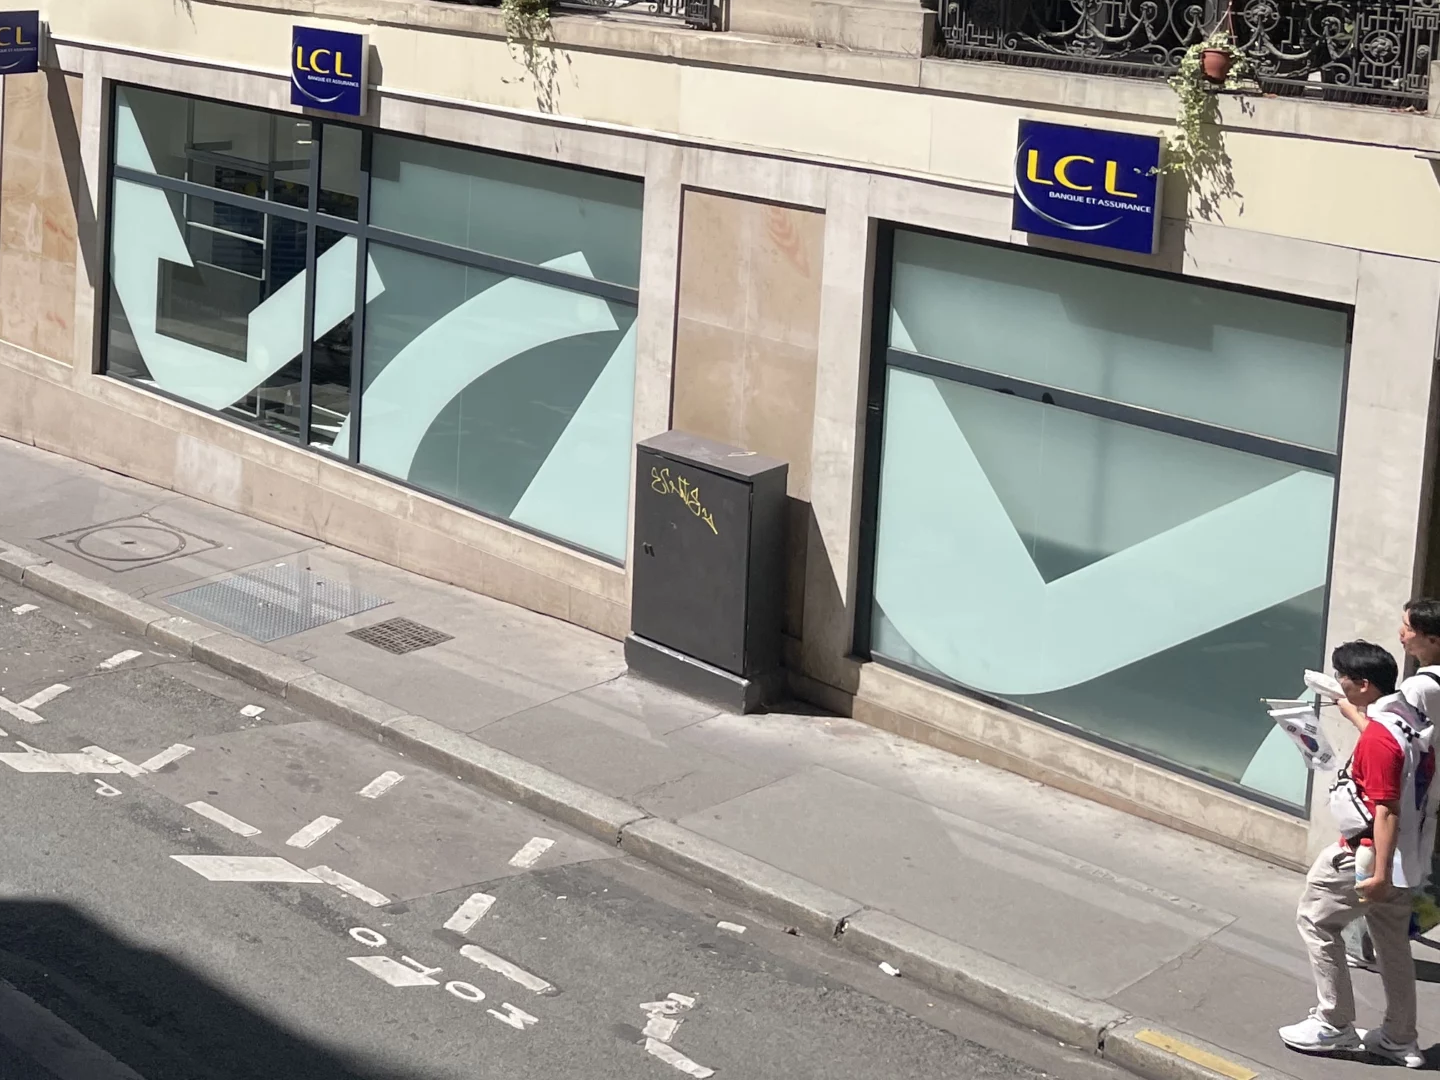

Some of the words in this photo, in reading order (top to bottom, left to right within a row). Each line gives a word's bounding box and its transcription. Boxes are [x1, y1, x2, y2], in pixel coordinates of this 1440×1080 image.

[296, 45, 353, 78] LCL
[307, 74, 326, 83] BANQUE
[332, 78, 360, 88] ASSURANCE
[1027, 149, 1137, 198] LCL
[1049, 191, 1084, 203] BANQUE
[1086, 197, 1097, 205] ET
[1097, 199, 1151, 213] ASSURANCE
[348, 926, 540, 1030] MOTO
